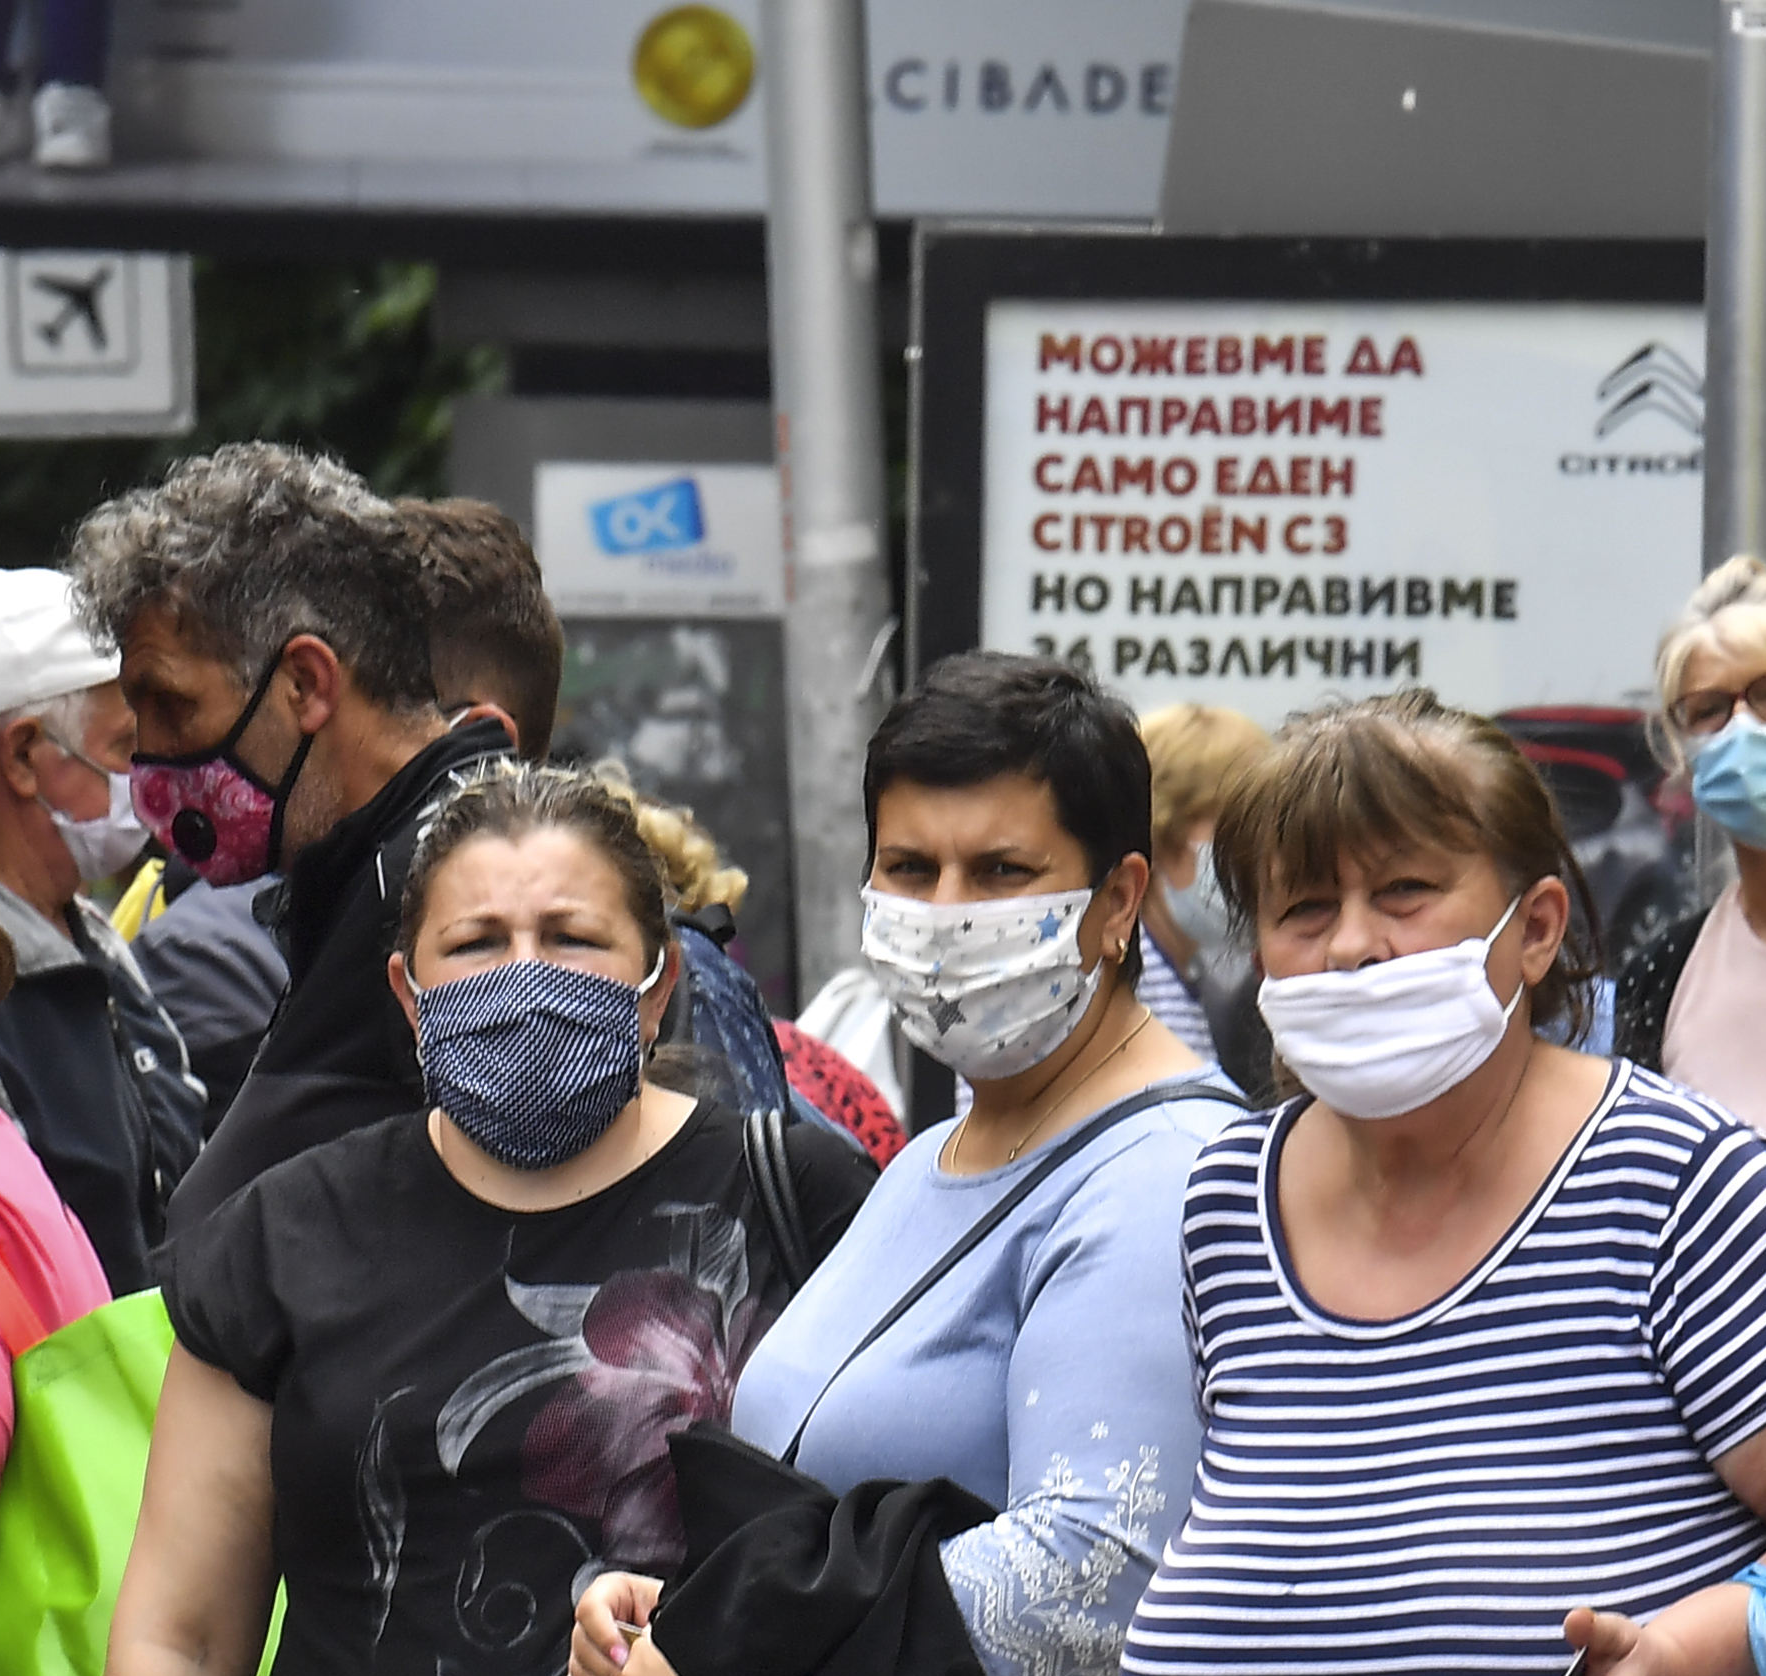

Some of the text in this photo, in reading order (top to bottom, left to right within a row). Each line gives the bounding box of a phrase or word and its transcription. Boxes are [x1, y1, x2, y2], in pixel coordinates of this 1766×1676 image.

[885, 57, 1171, 115] CIBADE
[1038, 334, 1424, 377] МОЖЕВМЕ ДА
[1035, 395, 1384, 437] НАПРАВИМЕ
[1033, 455, 1354, 497] САМО ЕДЕН
[1558, 450, 1704, 474] CITROË
[1032, 504, 1348, 555] CITROËN C3
[1031, 573, 1518, 620] НО НАПРАВИВМЕ
[1113, 636, 1422, 678] РАЗЛИЧНИ
